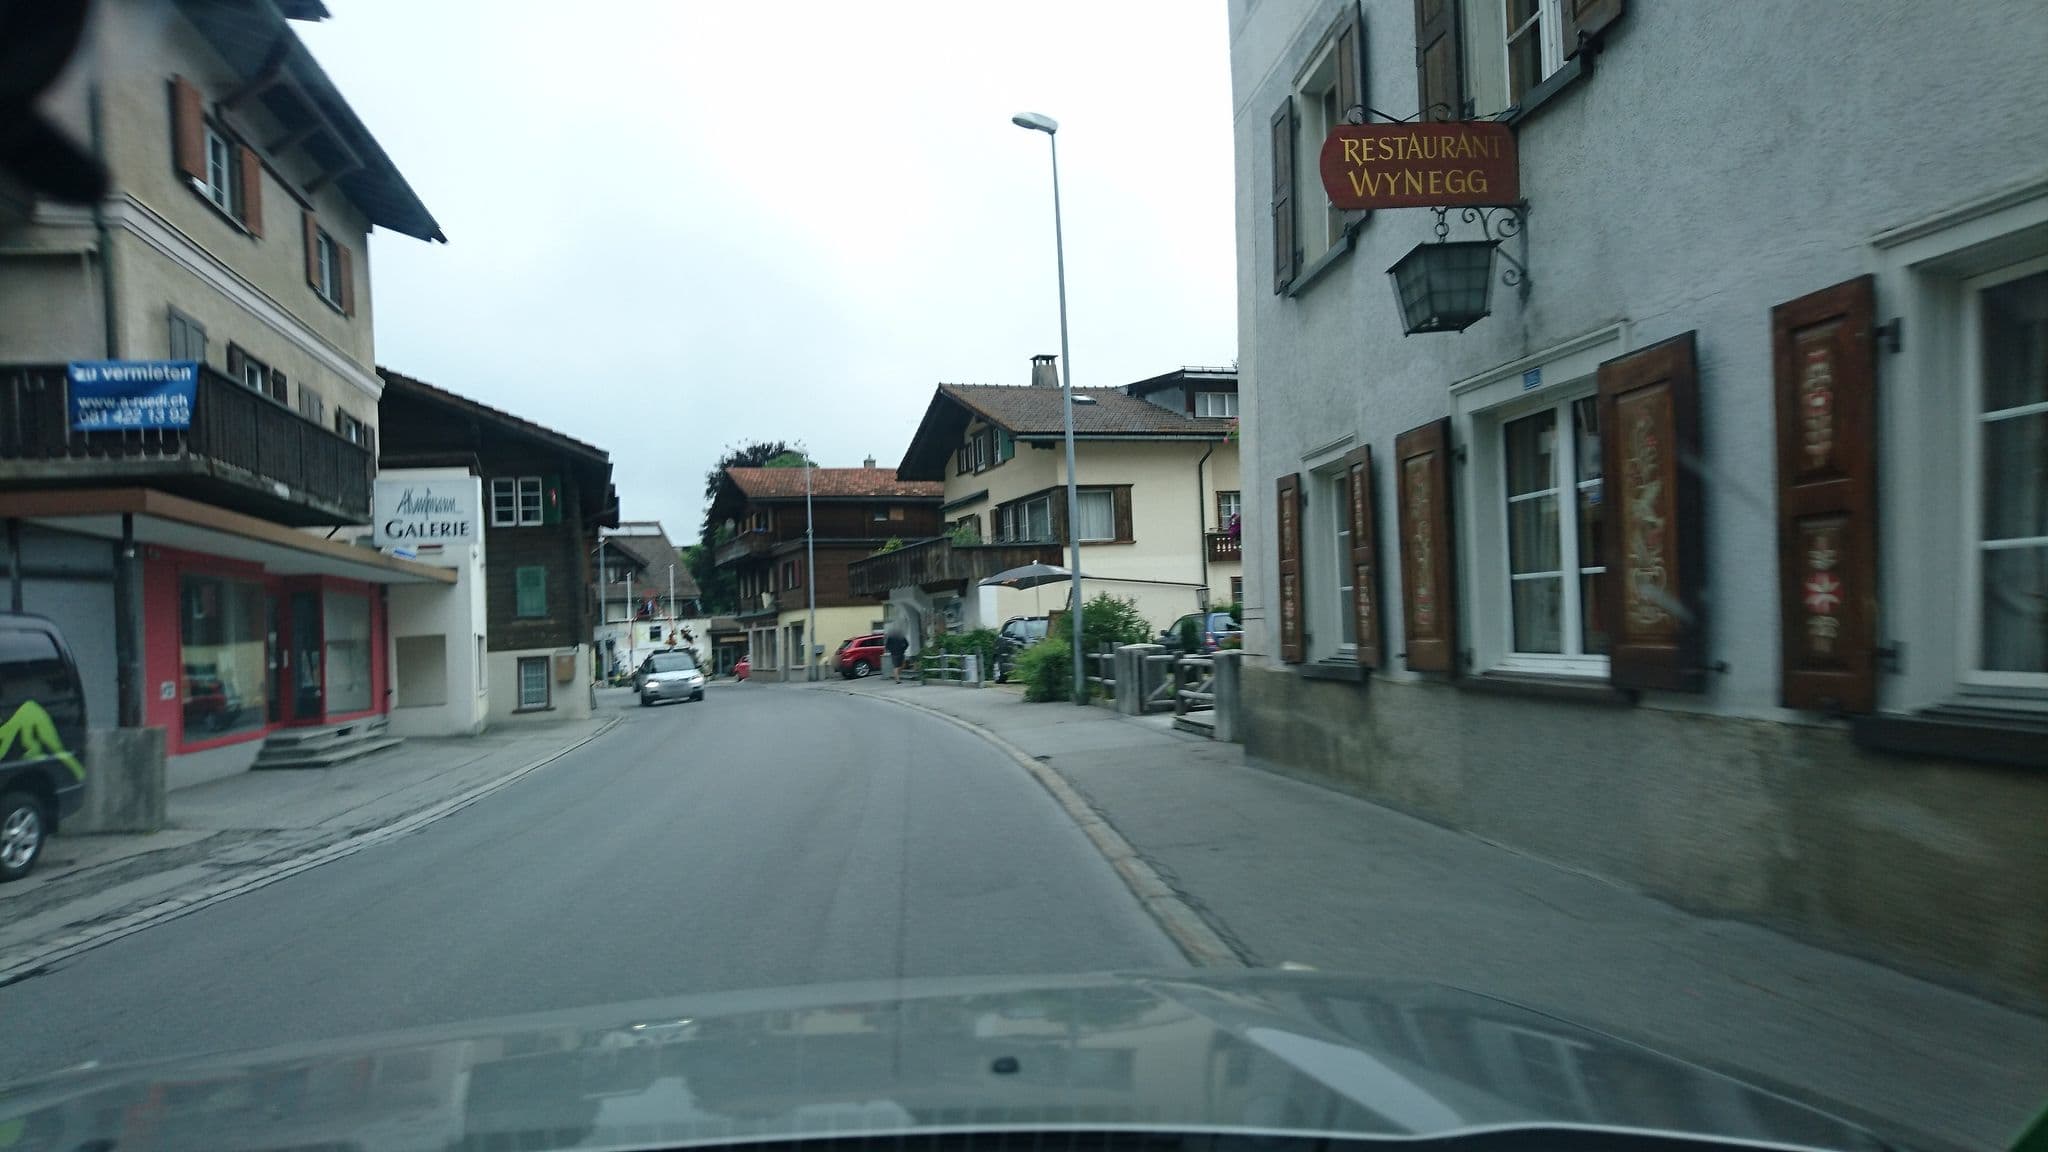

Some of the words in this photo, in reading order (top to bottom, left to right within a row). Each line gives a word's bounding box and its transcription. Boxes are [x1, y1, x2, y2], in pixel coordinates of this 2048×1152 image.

[1339, 132, 1502, 166] RESTAURANT
[1348, 168, 1488, 197] WYNEGG
[102, 364, 191, 381] vermieten
[385, 520, 469, 539] GALERIE
